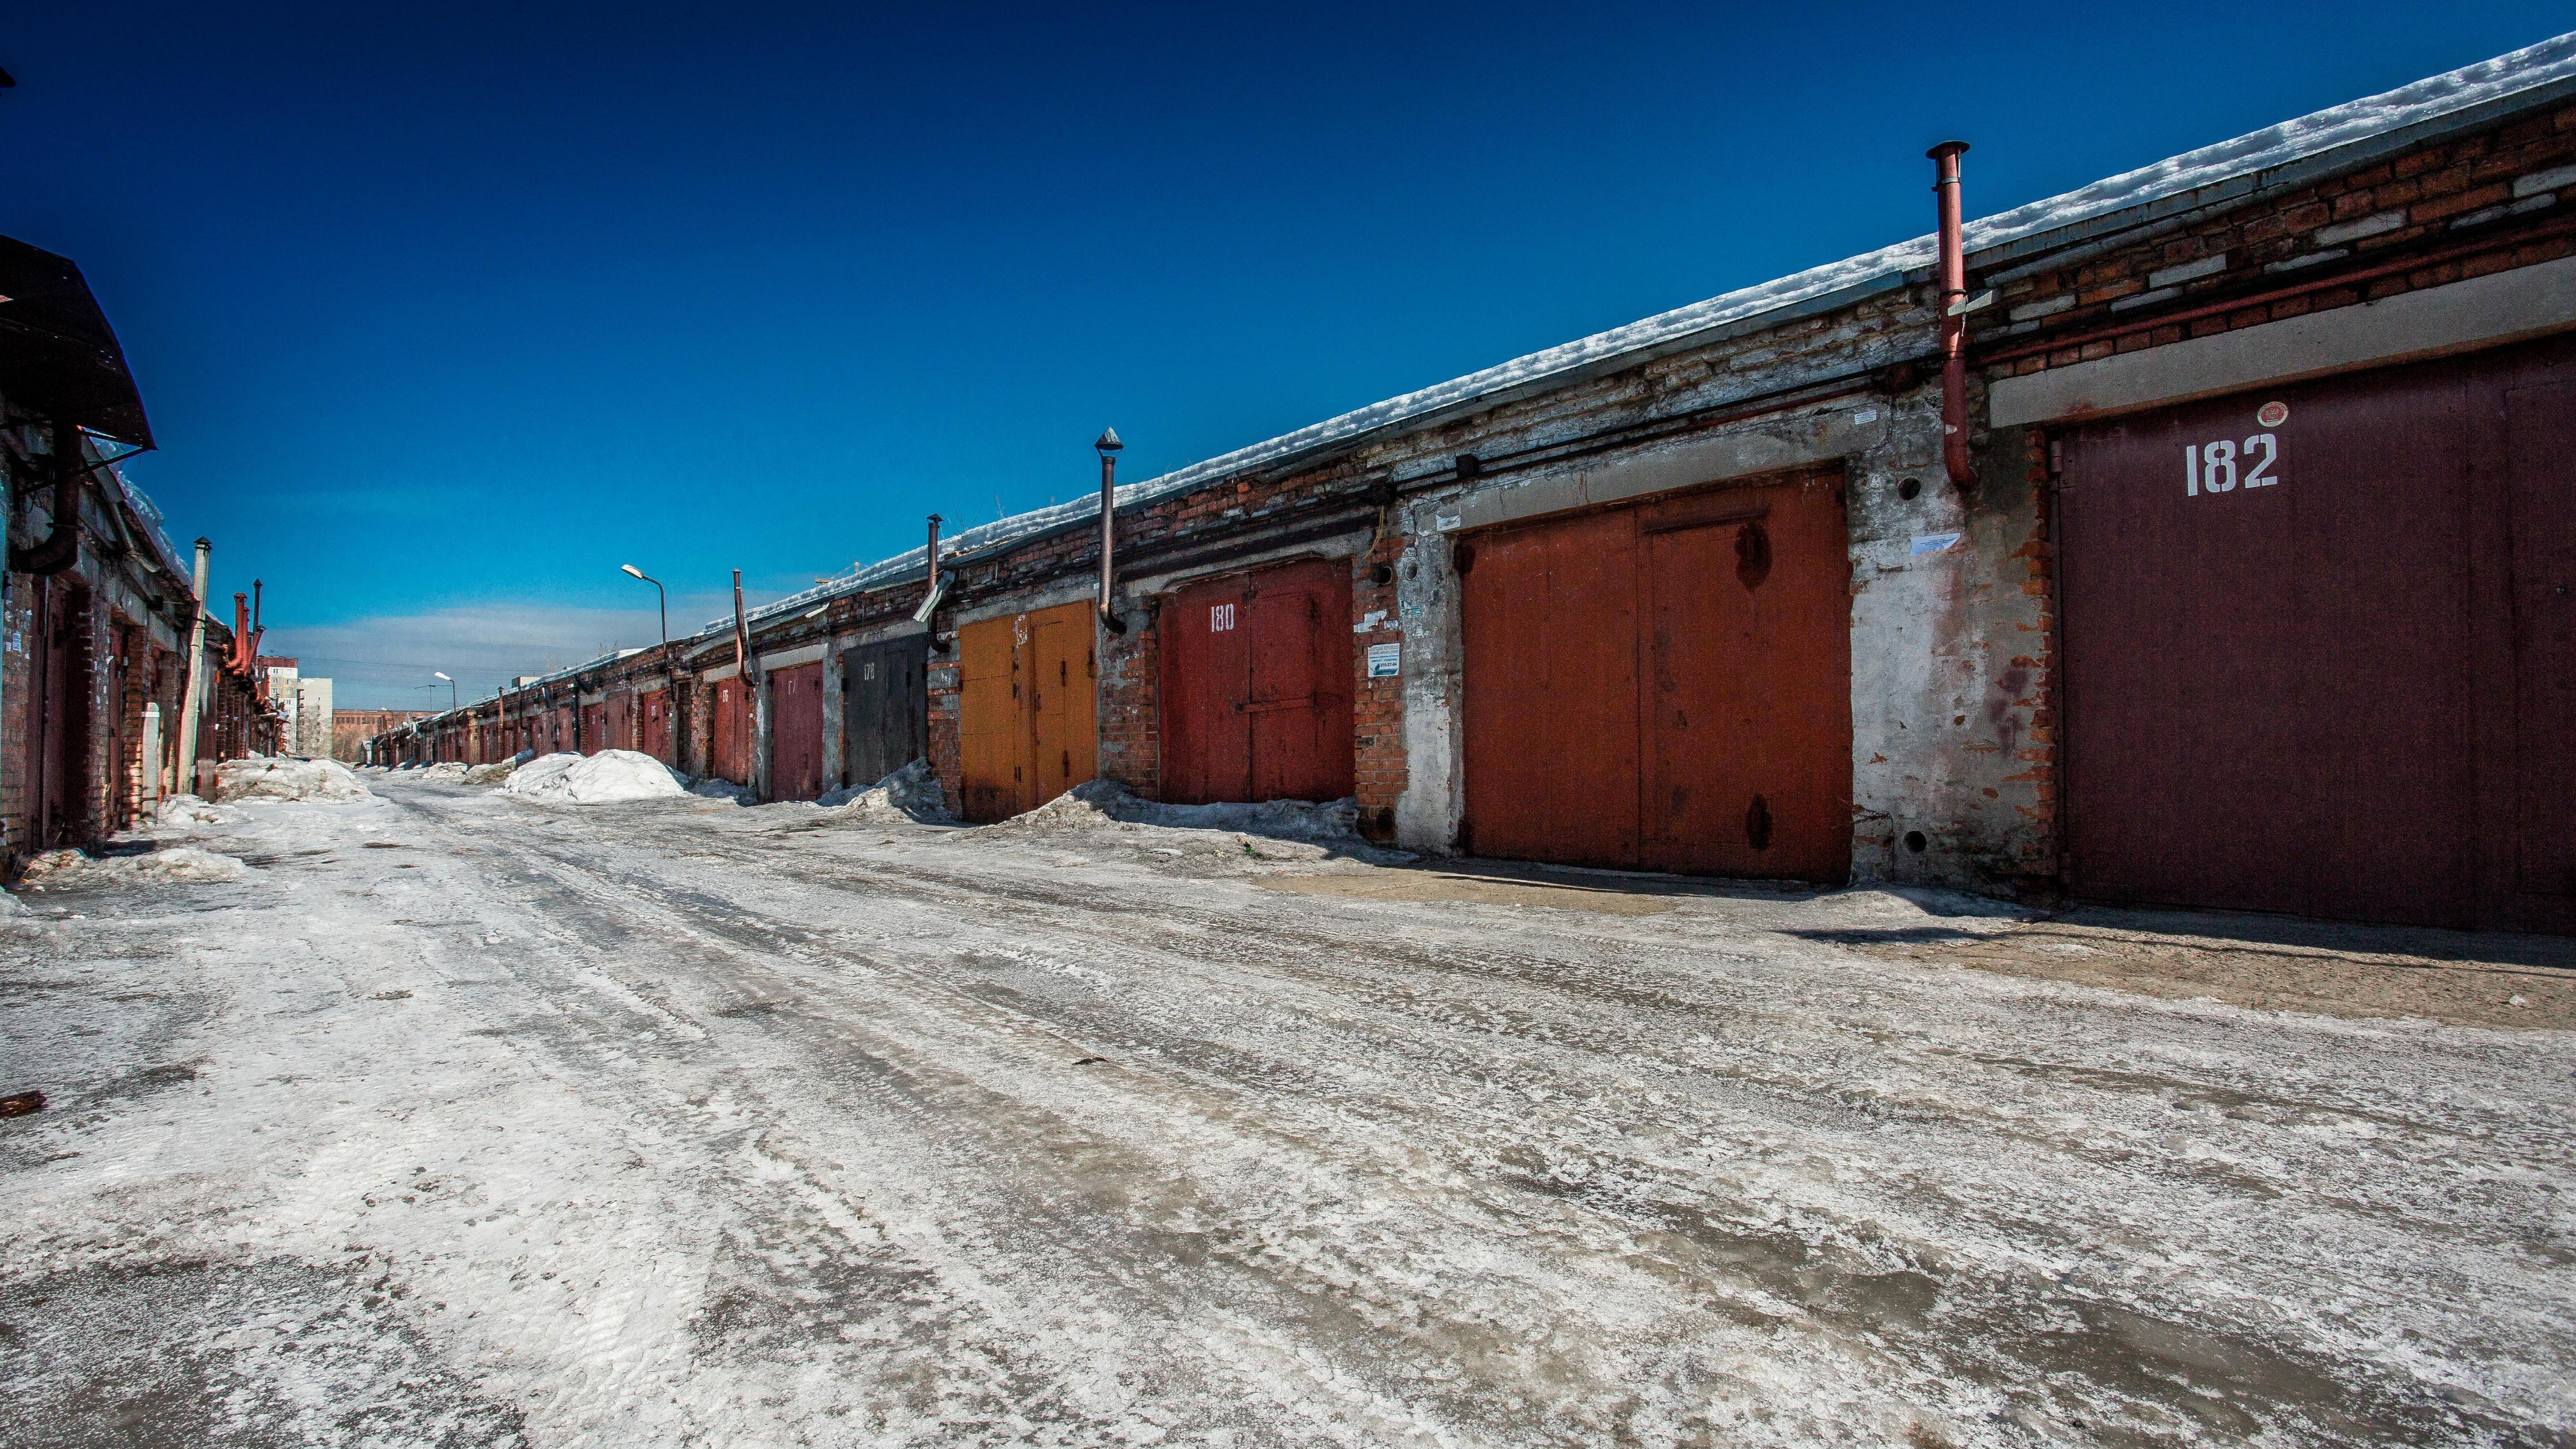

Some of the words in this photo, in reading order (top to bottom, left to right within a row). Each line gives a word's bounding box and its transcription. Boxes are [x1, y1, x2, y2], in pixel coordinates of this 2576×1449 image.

[2186, 433, 2277, 496] 182
[1211, 603, 1234, 633] 180
[864, 662, 874, 680] 178
